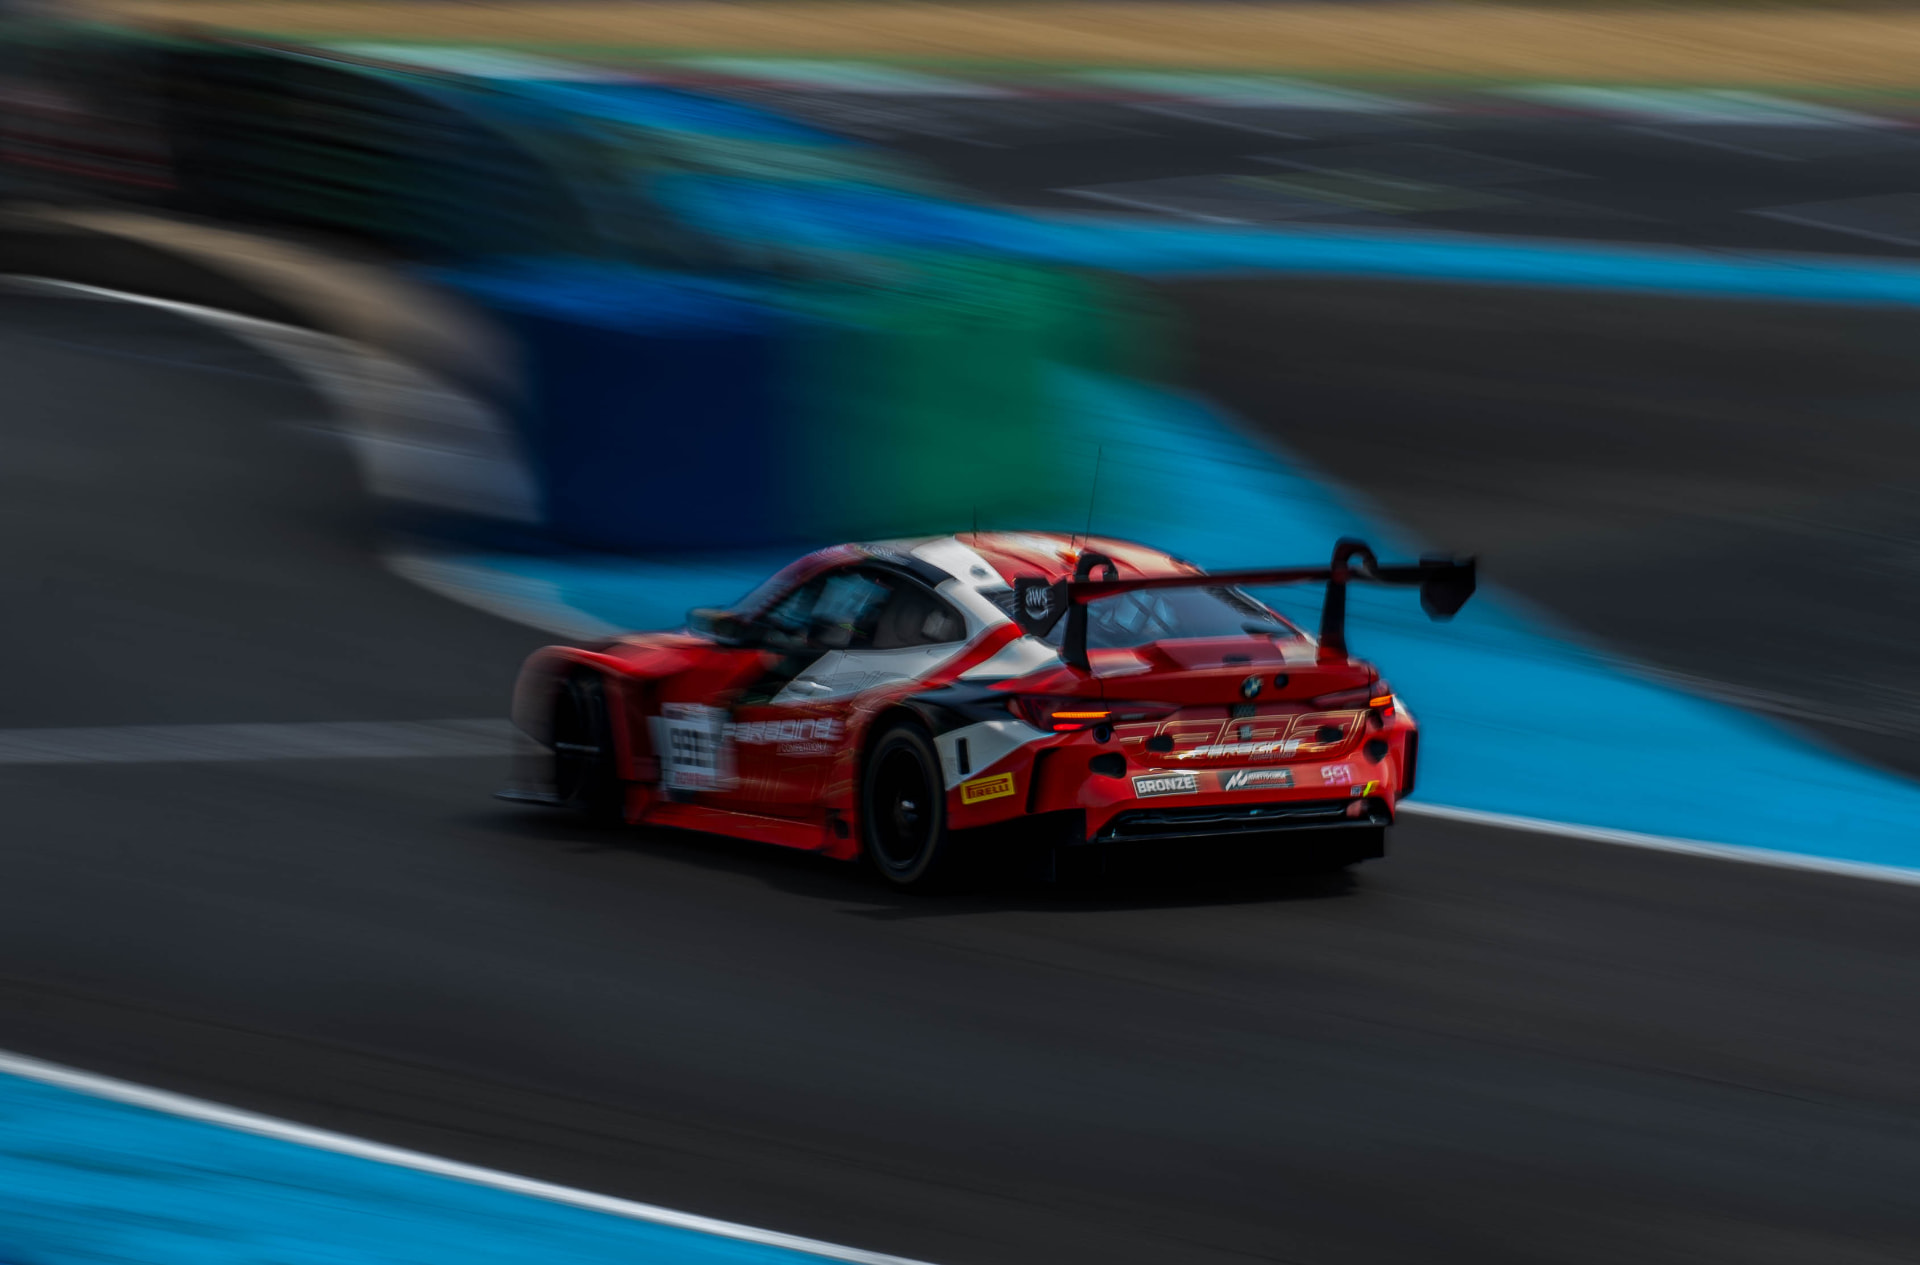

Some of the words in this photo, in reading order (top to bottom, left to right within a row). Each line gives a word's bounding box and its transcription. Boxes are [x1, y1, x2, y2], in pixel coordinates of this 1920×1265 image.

[1321, 765, 1352, 785] 991
[965, 778, 1010, 799] PIRELLI
[1136, 777, 1195, 794] BRONZE
